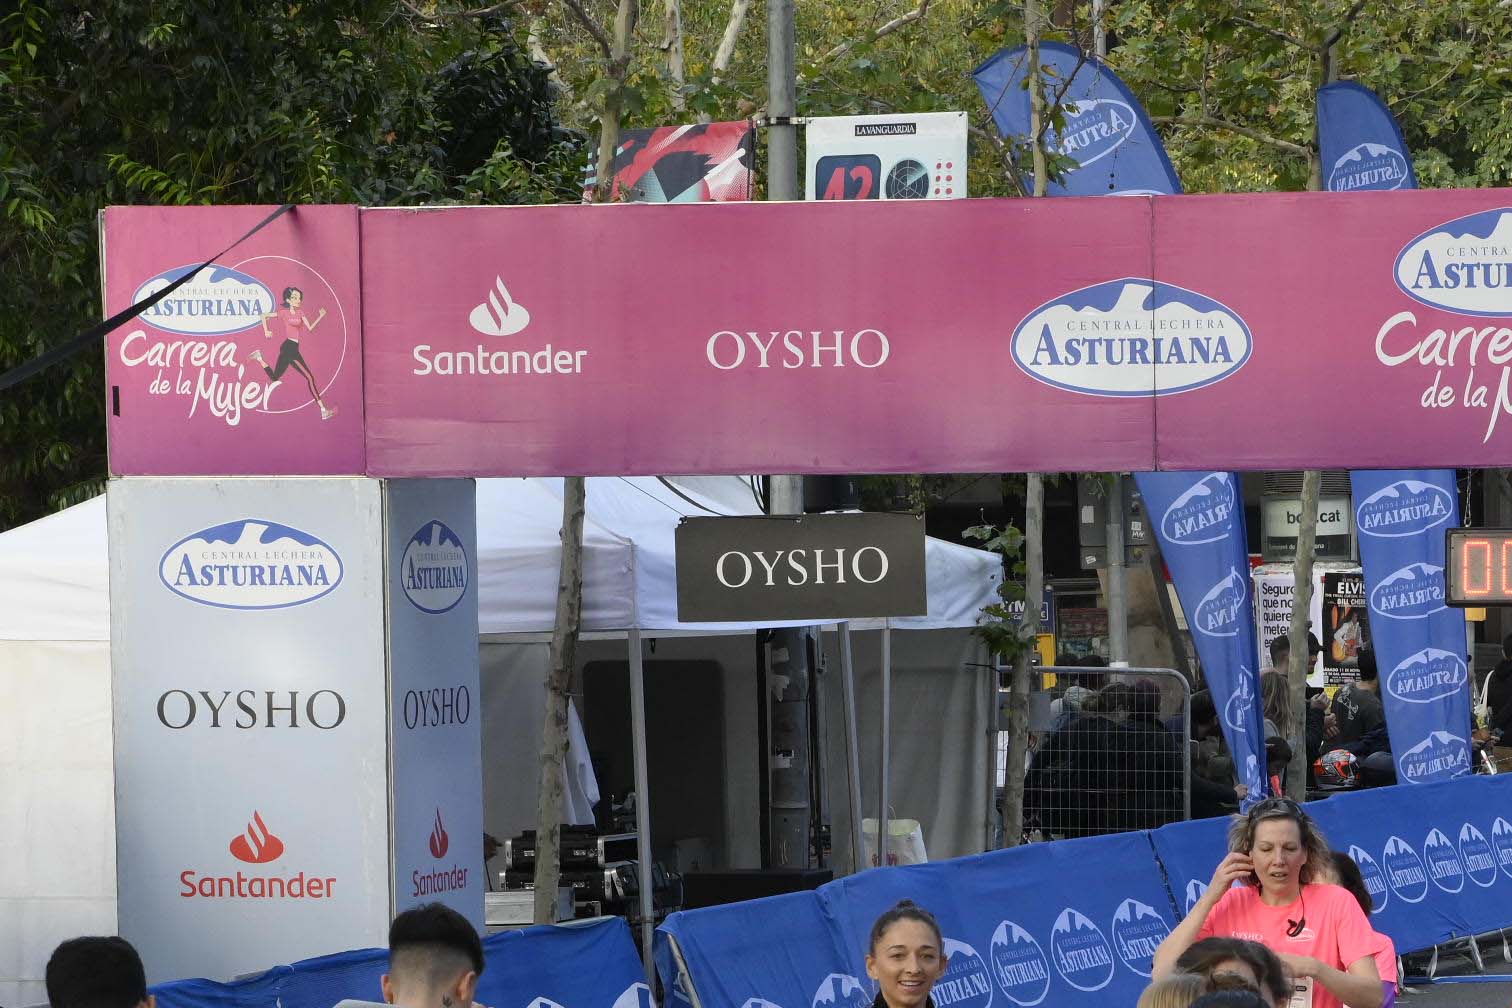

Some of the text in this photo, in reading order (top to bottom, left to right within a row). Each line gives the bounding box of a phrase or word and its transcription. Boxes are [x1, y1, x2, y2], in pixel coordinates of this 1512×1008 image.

[144, 290, 263, 316] ASTURIANA
[172, 287, 212, 296] ENTRAL
[1067, 318, 1225, 331] CENTRAL LECHERA
[120, 330, 237, 367] Carrera
[413, 344, 588, 375] Santander
[705, 328, 891, 371] OYSHO
[1031, 324, 1234, 367] ASTURIANA
[150, 364, 282, 425] de la Mujer
[1421, 369, 1456, 408] de
[1463, 368, 1488, 408] la
[174, 553, 330, 587] ASTURIANA
[202, 551, 324, 560] CENTRAL LECHERA
[406, 554, 465, 590] ASTURIANA
[716, 547, 889, 588] OYSHO
[1262, 598, 1279, 610] que
[156, 689, 346, 730] OYSHO
[403, 685, 470, 730] OYSHO
[180, 870, 337, 899] Santander
[412, 864, 468, 897] Santander
[995, 956, 1047, 988] ASTURIANA
[1057, 942, 1112, 973] ASTURIANA
[931, 971, 991, 1008] STURIANA
